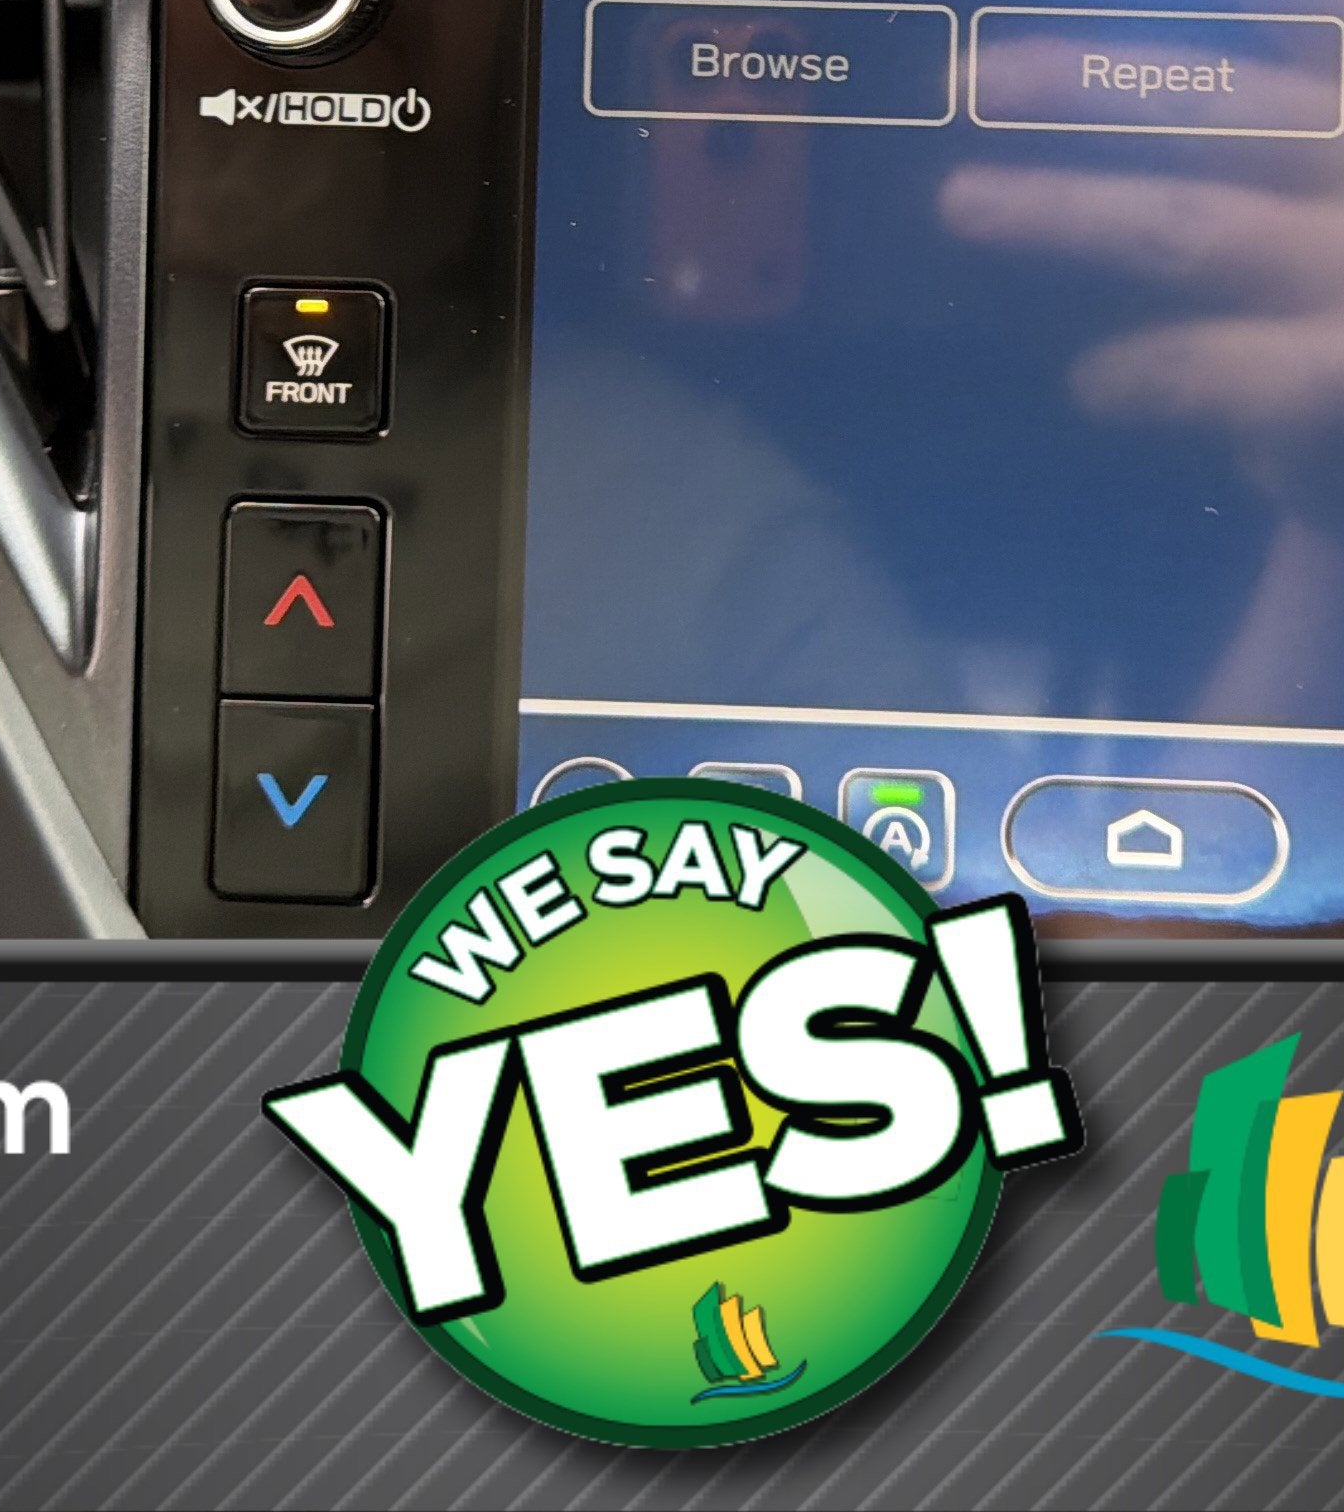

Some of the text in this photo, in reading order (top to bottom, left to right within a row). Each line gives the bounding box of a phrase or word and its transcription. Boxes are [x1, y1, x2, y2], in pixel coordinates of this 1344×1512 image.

[691, 43, 849, 82] Browse
[1082, 53, 1236, 99] Repeat
[265, 381, 352, 405] FRONT
